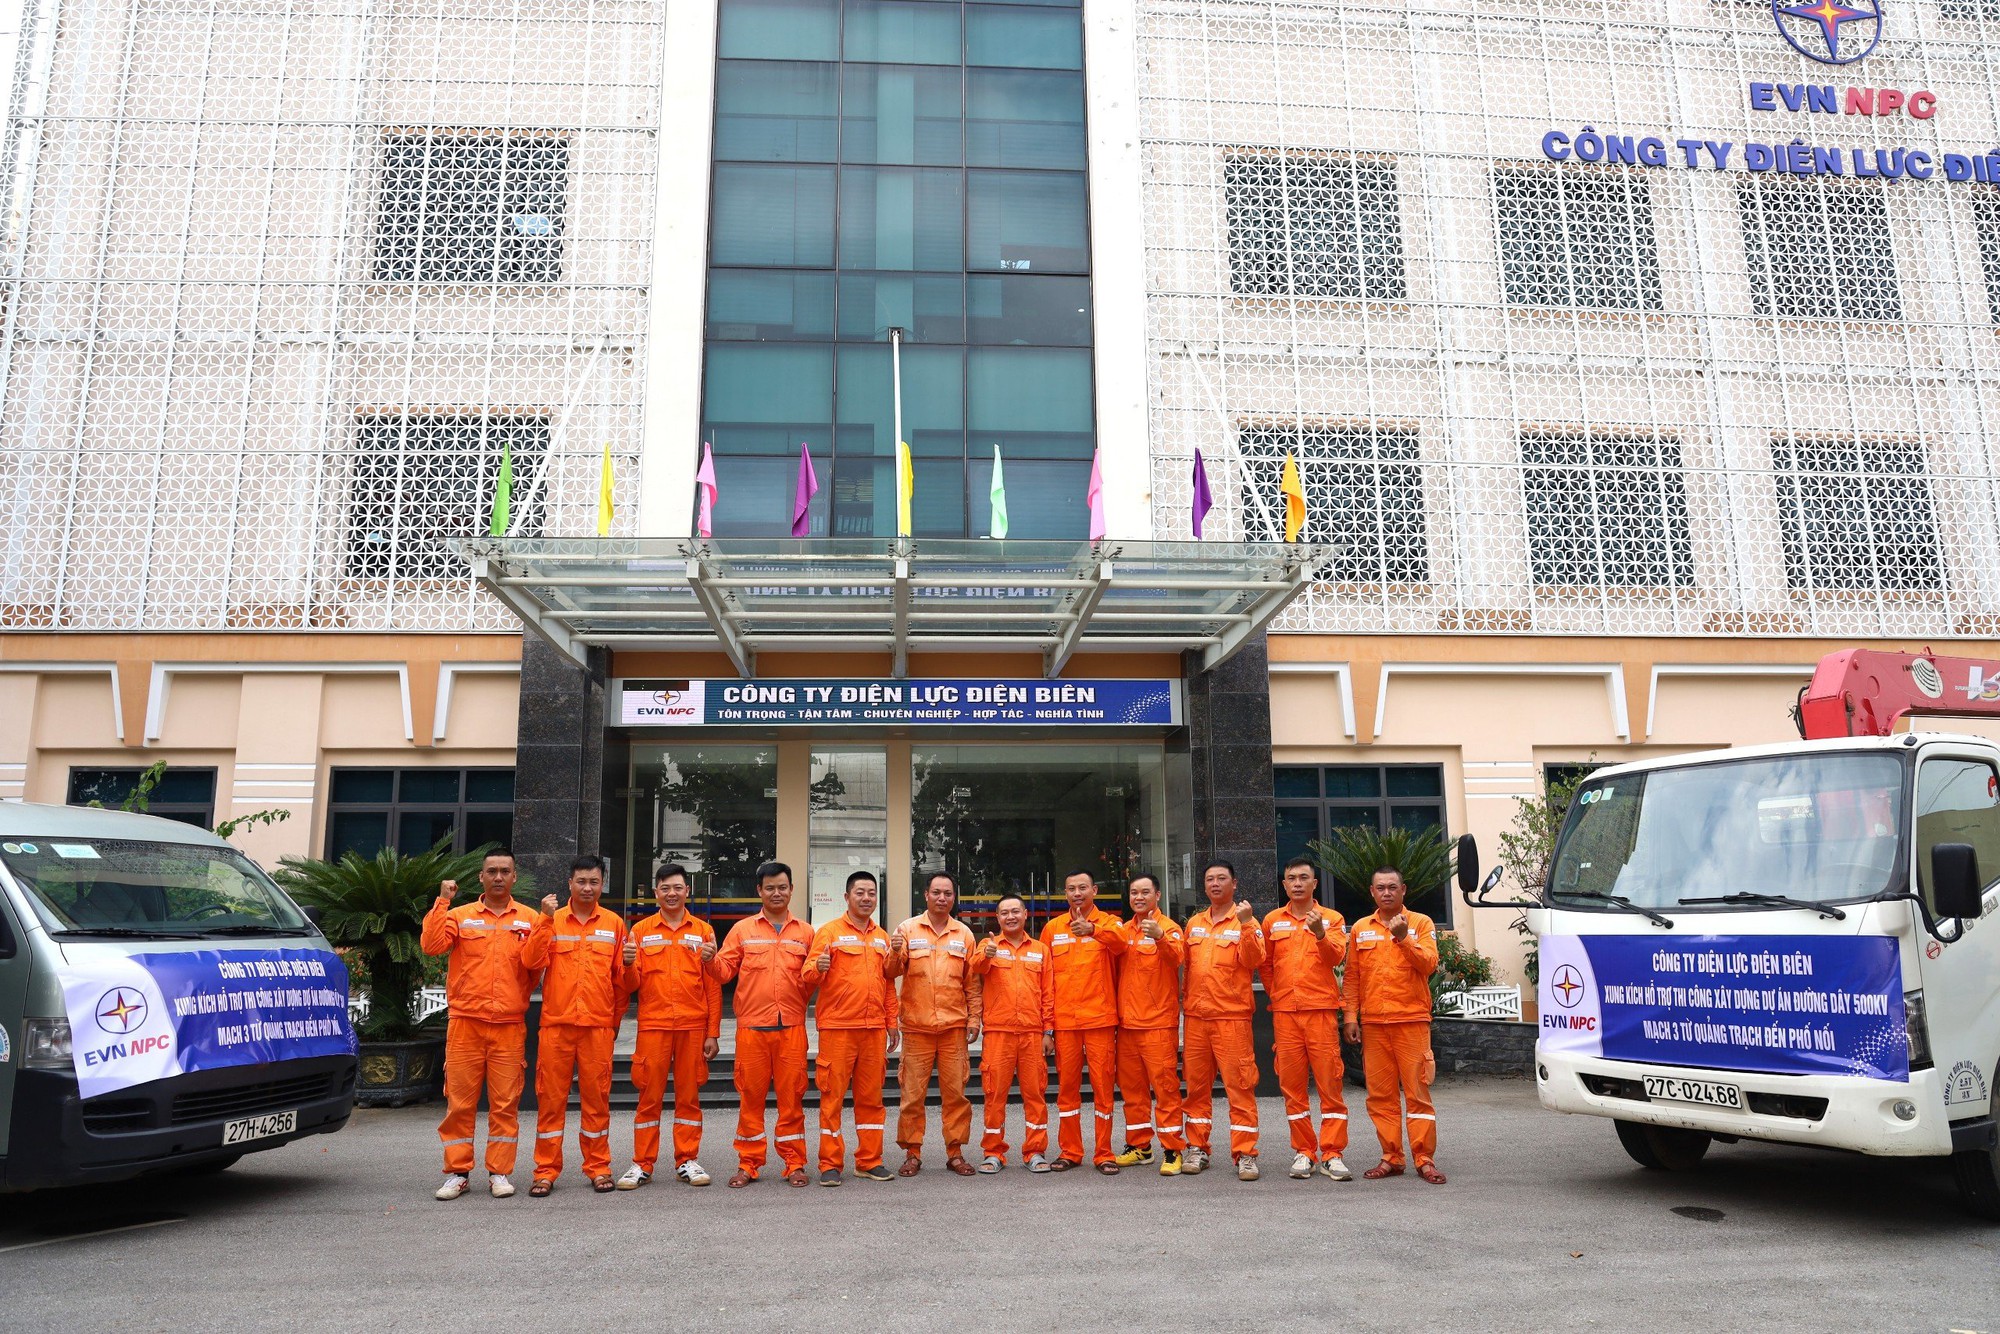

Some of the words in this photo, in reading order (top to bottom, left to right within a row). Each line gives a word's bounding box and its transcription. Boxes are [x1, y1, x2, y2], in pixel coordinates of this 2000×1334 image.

[1749, 82, 1837, 114] EVN
[1845, 87, 1937, 119] NPC
[1541, 125, 1667, 168] CÔNG
[1677, 139, 1733, 170] TY
[1744, 137, 1844, 181] ĐIỆN
[1853, 146, 1934, 184] LỰC
[723, 684, 796, 704] CÔNG
[803, 687, 833, 704] TY
[841, 684, 903, 706] ĐIỆN
[910, 685, 959, 706] LỰC
[966, 684, 1028, 707] ĐIỆN
[1035, 684, 1096, 703] BIÊN
[667, 707, 695, 715] NPC
[718, 708, 745, 719] TÔN
[746, 710, 786, 721] TRỌNG
[798, 708, 825, 721] TẬN
[825, 708, 852, 719] TÂM
[863, 708, 912, 719] CHUYÊN
[916, 708, 962, 720] NGHIỆP
[972, 709, 999, 720] HỢP
[1000, 707, 1024, 719] TÁC
[1035, 708, 1073, 719] NGHĨA
[1075, 708, 1104, 719] TÌNH
[219, 959, 246, 979] CÔNG
[246, 962, 257, 977] TY
[1652, 949, 1681, 973] CÔNG
[1683, 953, 1699, 973] TY
[1698, 949, 1725, 978] ĐIỆN
[1727, 951, 1748, 978] LỰC
[1751, 950, 1780, 979] ĐIỆN
[1782, 951, 1813, 976] BIÊN
[174, 996, 197, 1017] XUNG
[197, 991, 217, 1015] KÍCH
[228, 991, 244, 1015] TRỢ
[243, 991, 257, 1010] THI
[255, 987, 273, 1009] CÔNG
[273, 986, 286, 1008] XÂY
[1604, 985, 1625, 1004] XUNG
[1625, 982, 1644, 1006] KÍCH
[1644, 979, 1656, 1006] HỖ
[1657, 986, 1673, 1011] TRỢ
[1673, 987, 1687, 1008] THI
[1688, 984, 1713, 1009] CÔNG
[1714, 985, 1732, 1010] XÂY
[1734, 988, 1761, 1014] DỰNG
[1762, 988, 1776, 1015] DỰ
[1778, 986, 1792, 1012] ÁN
[1793, 987, 1828, 1014] ĐƯỜNG
[1830, 988, 1851, 1015] DÂY
[1853, 994, 1888, 1016] 500KV
[217, 1023, 243, 1049] MẠCH
[244, 1026, 250, 1043] 3
[250, 1018, 263, 1042] TỪ
[284, 1021, 306, 1042] TRẠCH
[1543, 1014, 1568, 1029] EVN
[1569, 1016, 1596, 1031] NPC
[1643, 1020, 1671, 1044] MẠCH
[1672, 1021, 1680, 1041] 3
[1680, 1017, 1694, 1042] TỪ
[1694, 1015, 1728, 1044] QUẢNG
[1728, 1025, 1762, 1050] TRẠCH
[1764, 1020, 1787, 1048] ĐẾN
[1789, 1022, 1812, 1051] PHỐ
[1813, 1023, 1836, 1051] NỐI
[84, 1043, 127, 1067] EVN
[130, 1034, 170, 1056] NPC
[1646, 1078, 1738, 1106] 27C-024.68
[228, 1113, 293, 1142] 27H-4256
